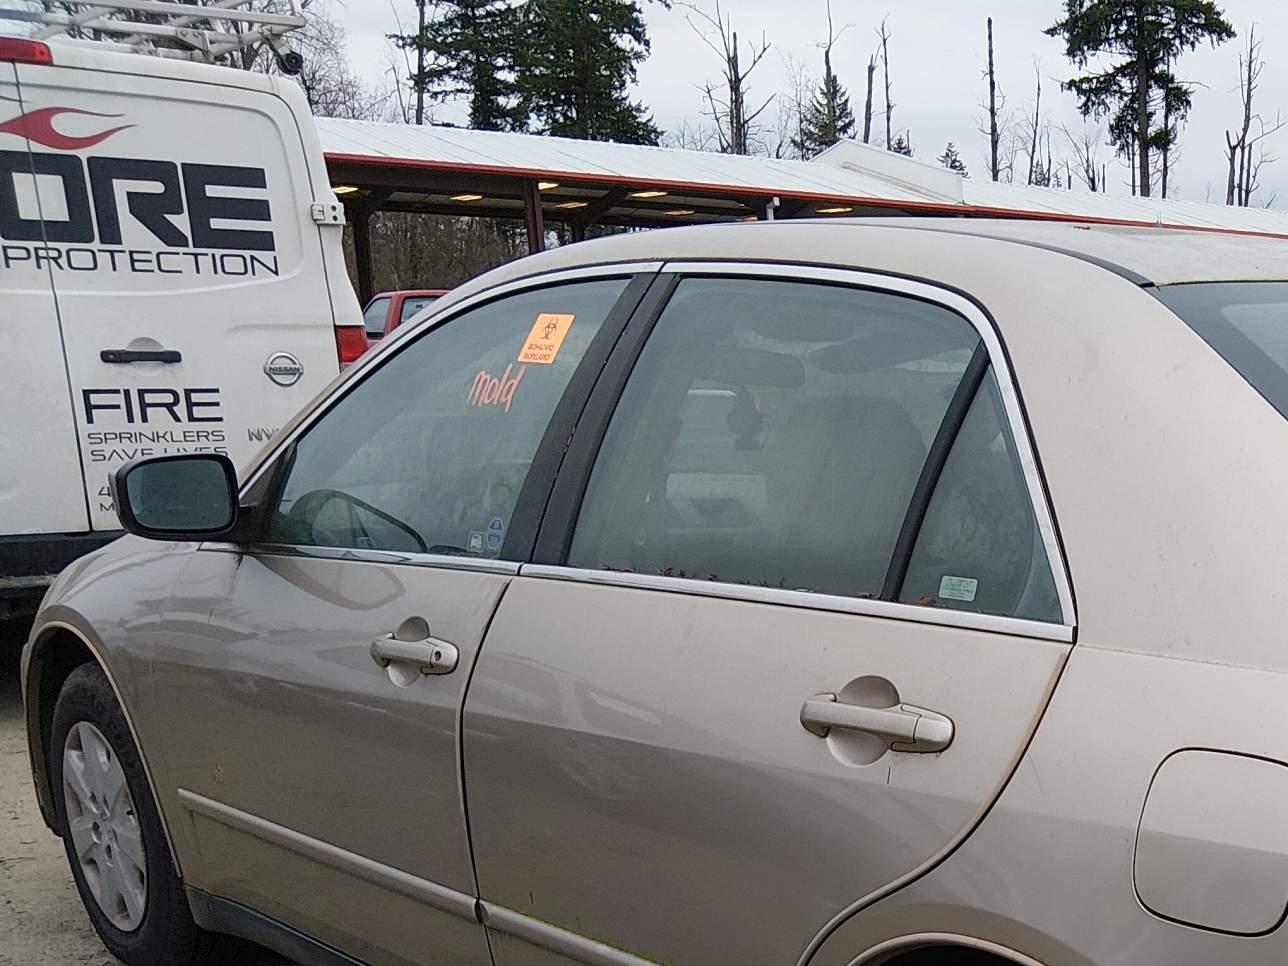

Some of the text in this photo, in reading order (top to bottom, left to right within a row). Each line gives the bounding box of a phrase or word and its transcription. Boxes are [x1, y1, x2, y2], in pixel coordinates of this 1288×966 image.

[3, 246, 280, 277] PROTECTION
[268, 366, 300, 374] NISSAN
[466, 362, 527, 414] mold
[82, 388, 224, 424] FIRE
[87, 430, 225, 445] SPRINKLERS
